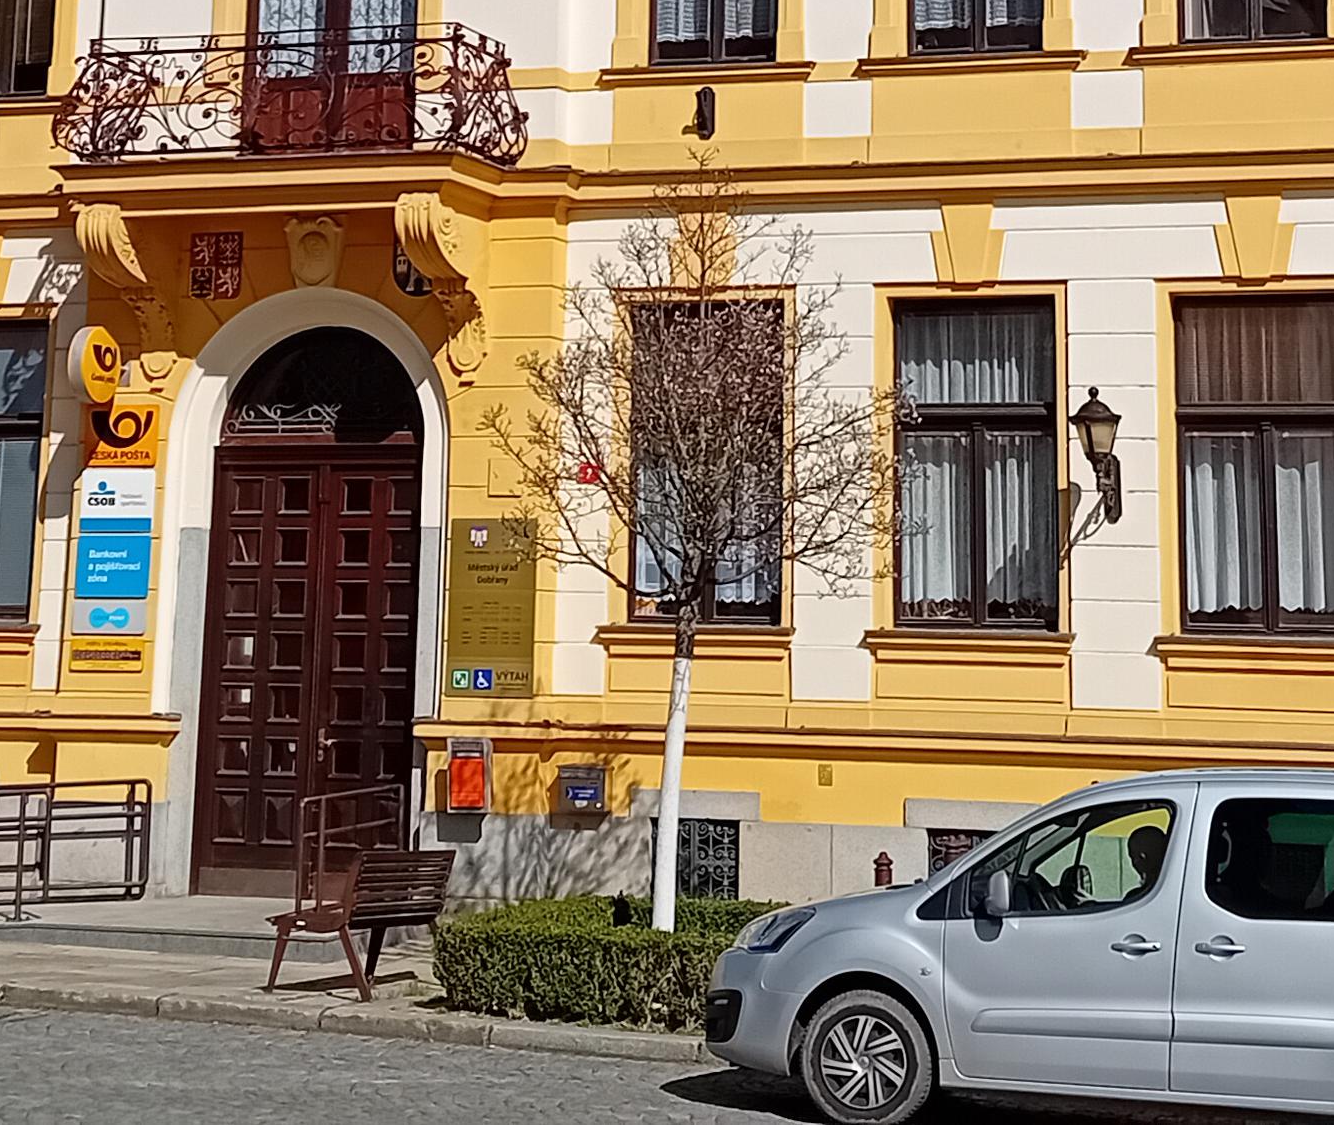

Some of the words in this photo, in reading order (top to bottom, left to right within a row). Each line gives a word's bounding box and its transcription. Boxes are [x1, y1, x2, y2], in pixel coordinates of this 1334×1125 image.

[120, 449, 151, 460] POŠTA
[88, 549, 128, 559] Bankovní
[88, 563, 94, 571] a
[467, 562, 500, 573] Městský
[87, 573, 108, 583] zóna
[476, 575, 508, 585] Dobřany
[495, 670, 529, 681] VÝTAH
